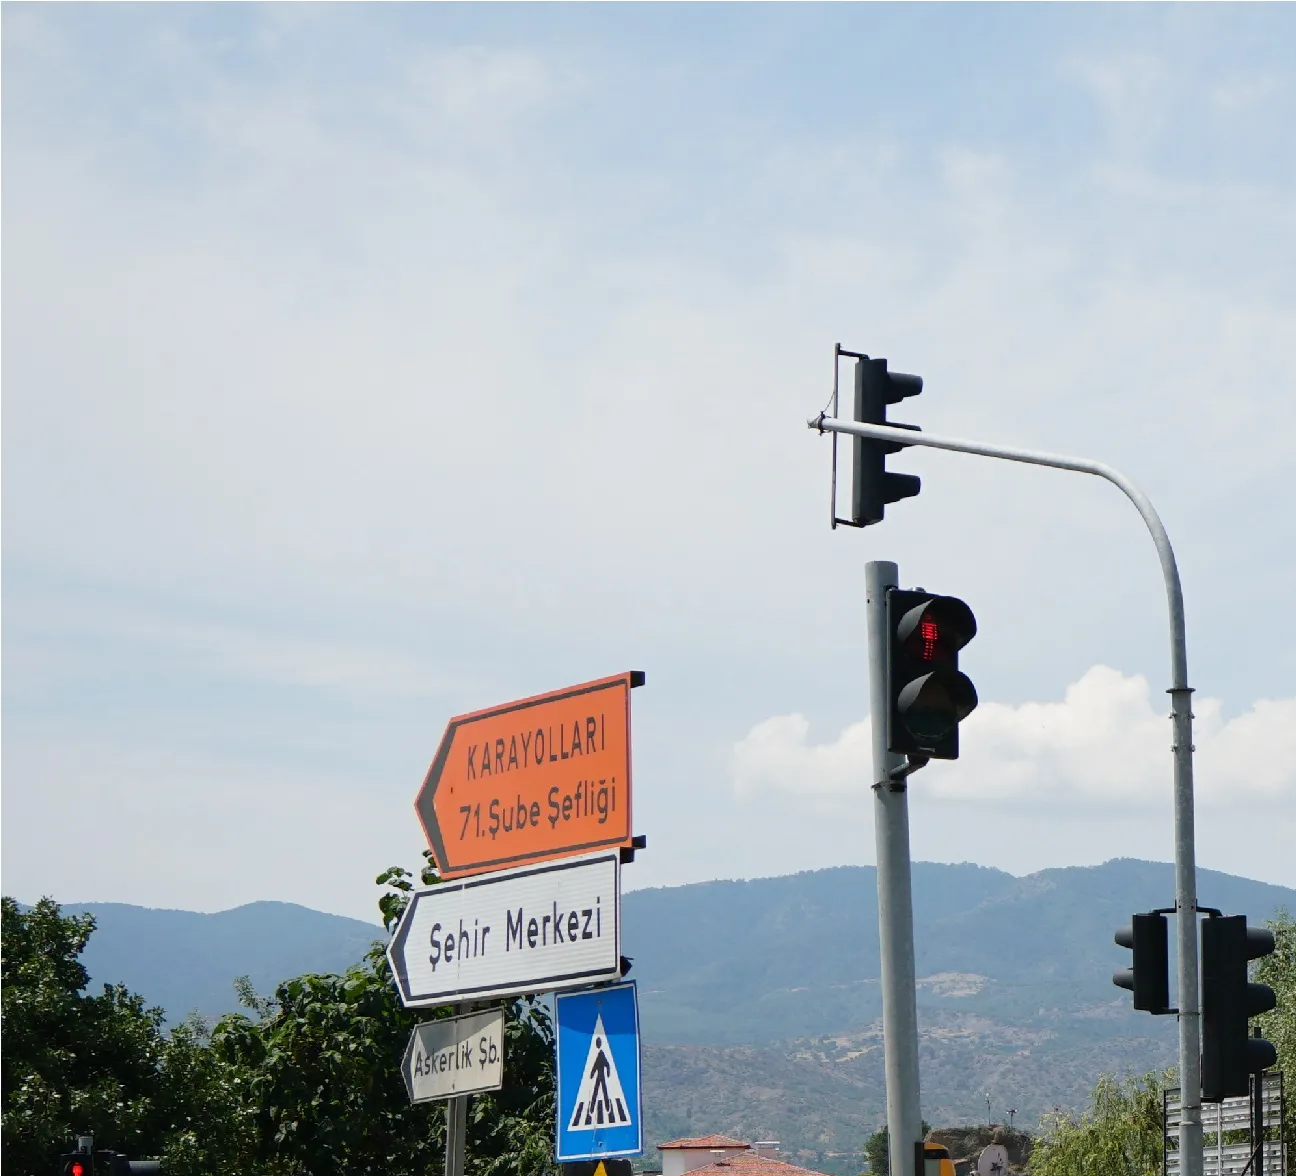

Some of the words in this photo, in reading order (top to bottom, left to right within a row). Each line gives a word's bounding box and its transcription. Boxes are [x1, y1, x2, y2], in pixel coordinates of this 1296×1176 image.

[467, 713, 605, 781] KARAYOLLARI
[459, 794, 541, 841] 71.Şube
[547, 776, 616, 830] Şefliği
[429, 918, 491, 973] Şehir
[506, 896, 601, 952] Merkezi
[413, 1040, 472, 1077] Askerlik
